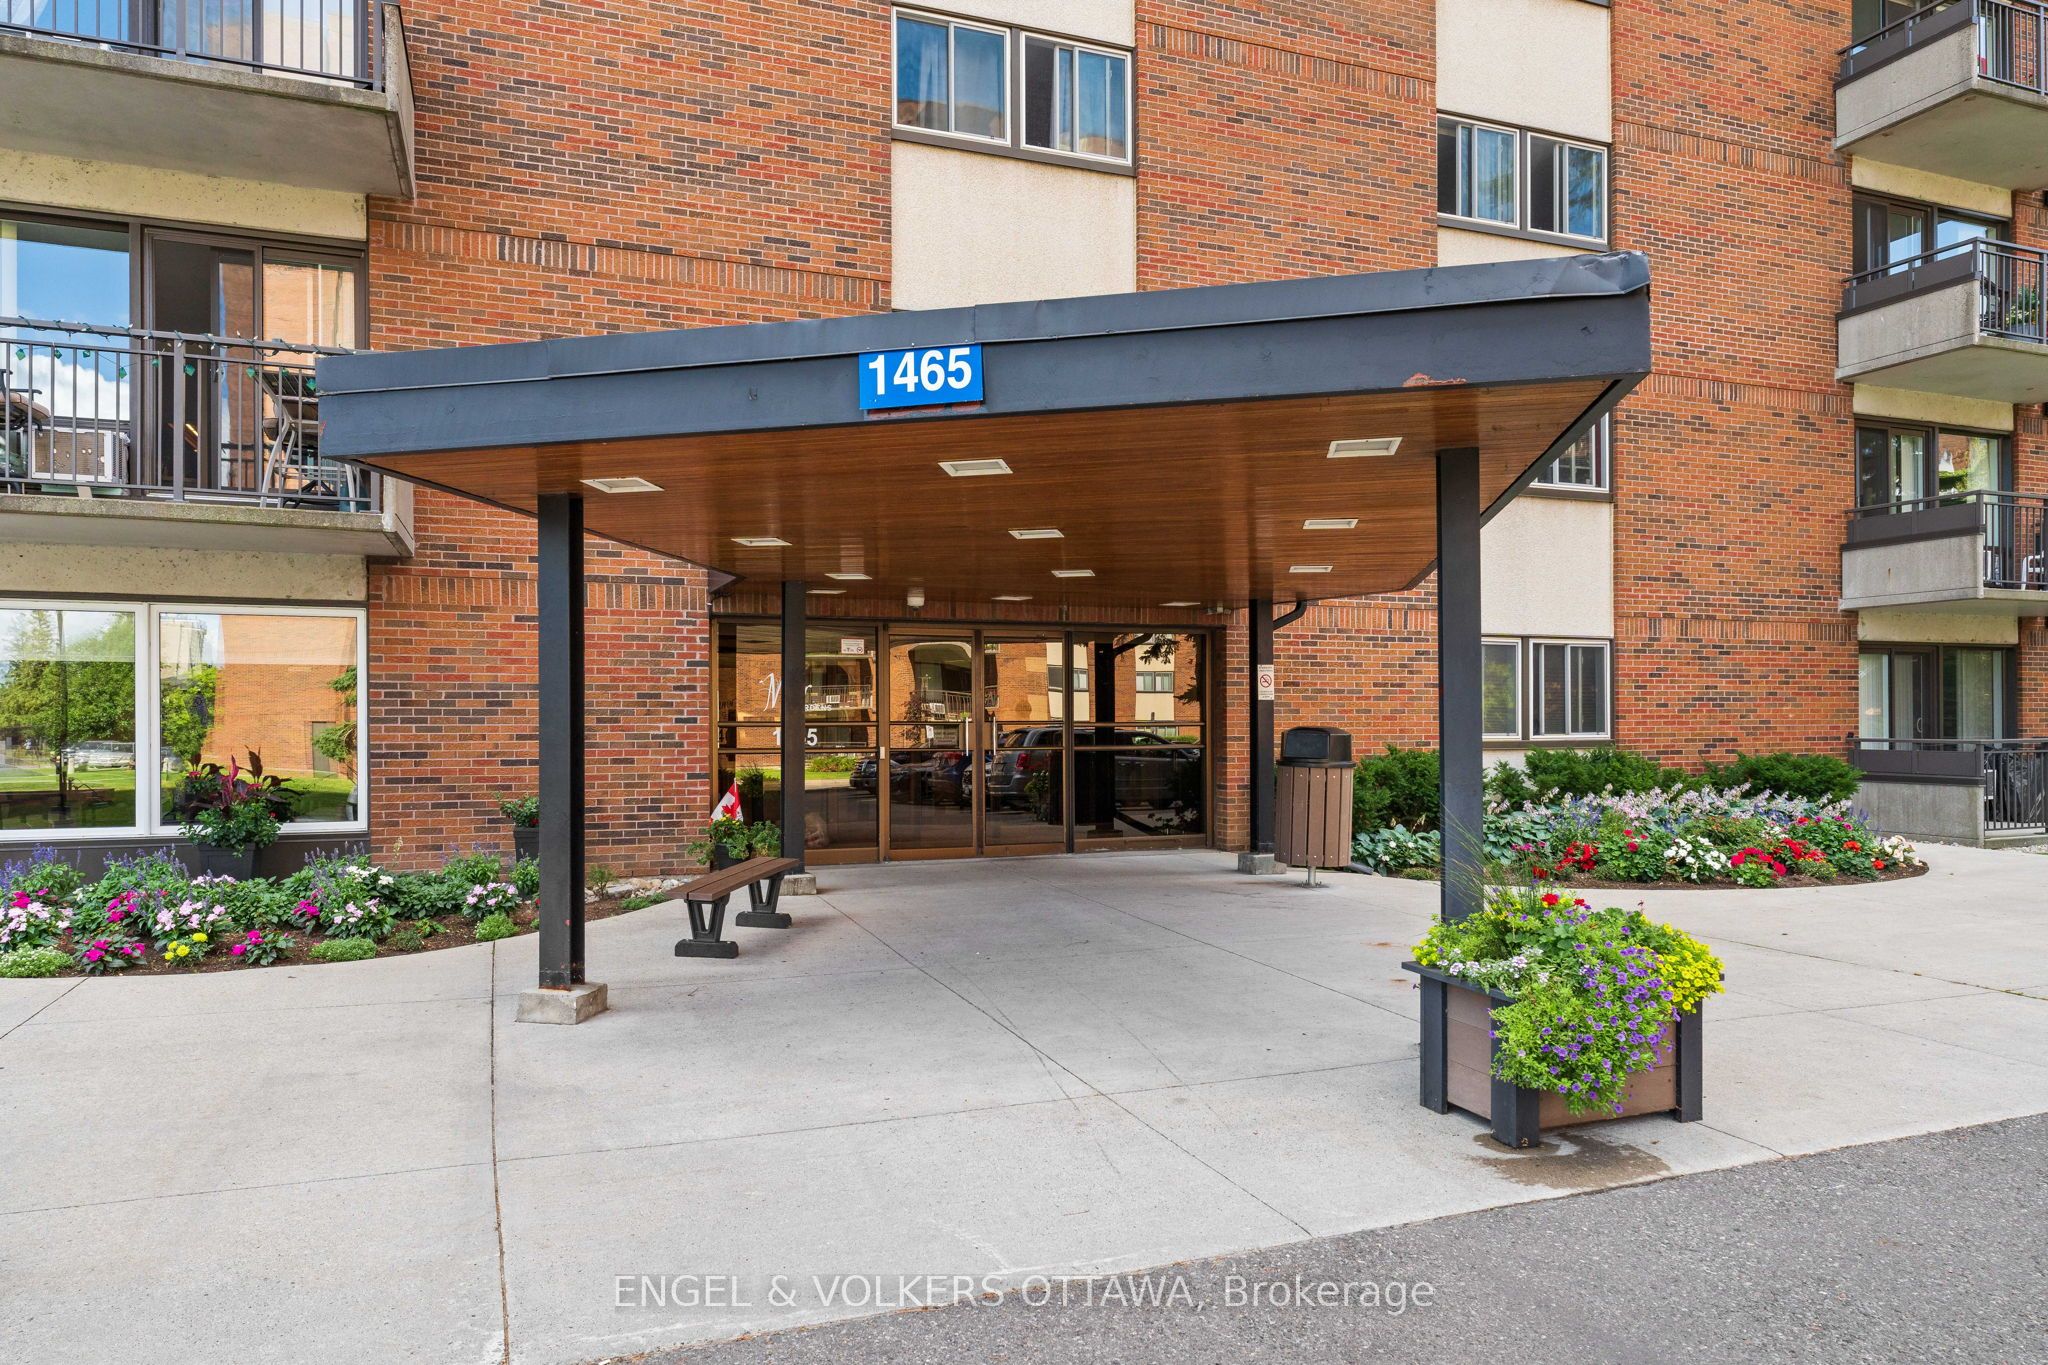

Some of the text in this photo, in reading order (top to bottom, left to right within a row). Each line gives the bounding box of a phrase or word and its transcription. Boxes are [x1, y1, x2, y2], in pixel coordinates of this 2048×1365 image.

[869, 347, 972, 395] 1465
[805, 704, 832, 712] RDENS
[772, 727, 818, 746] 15
